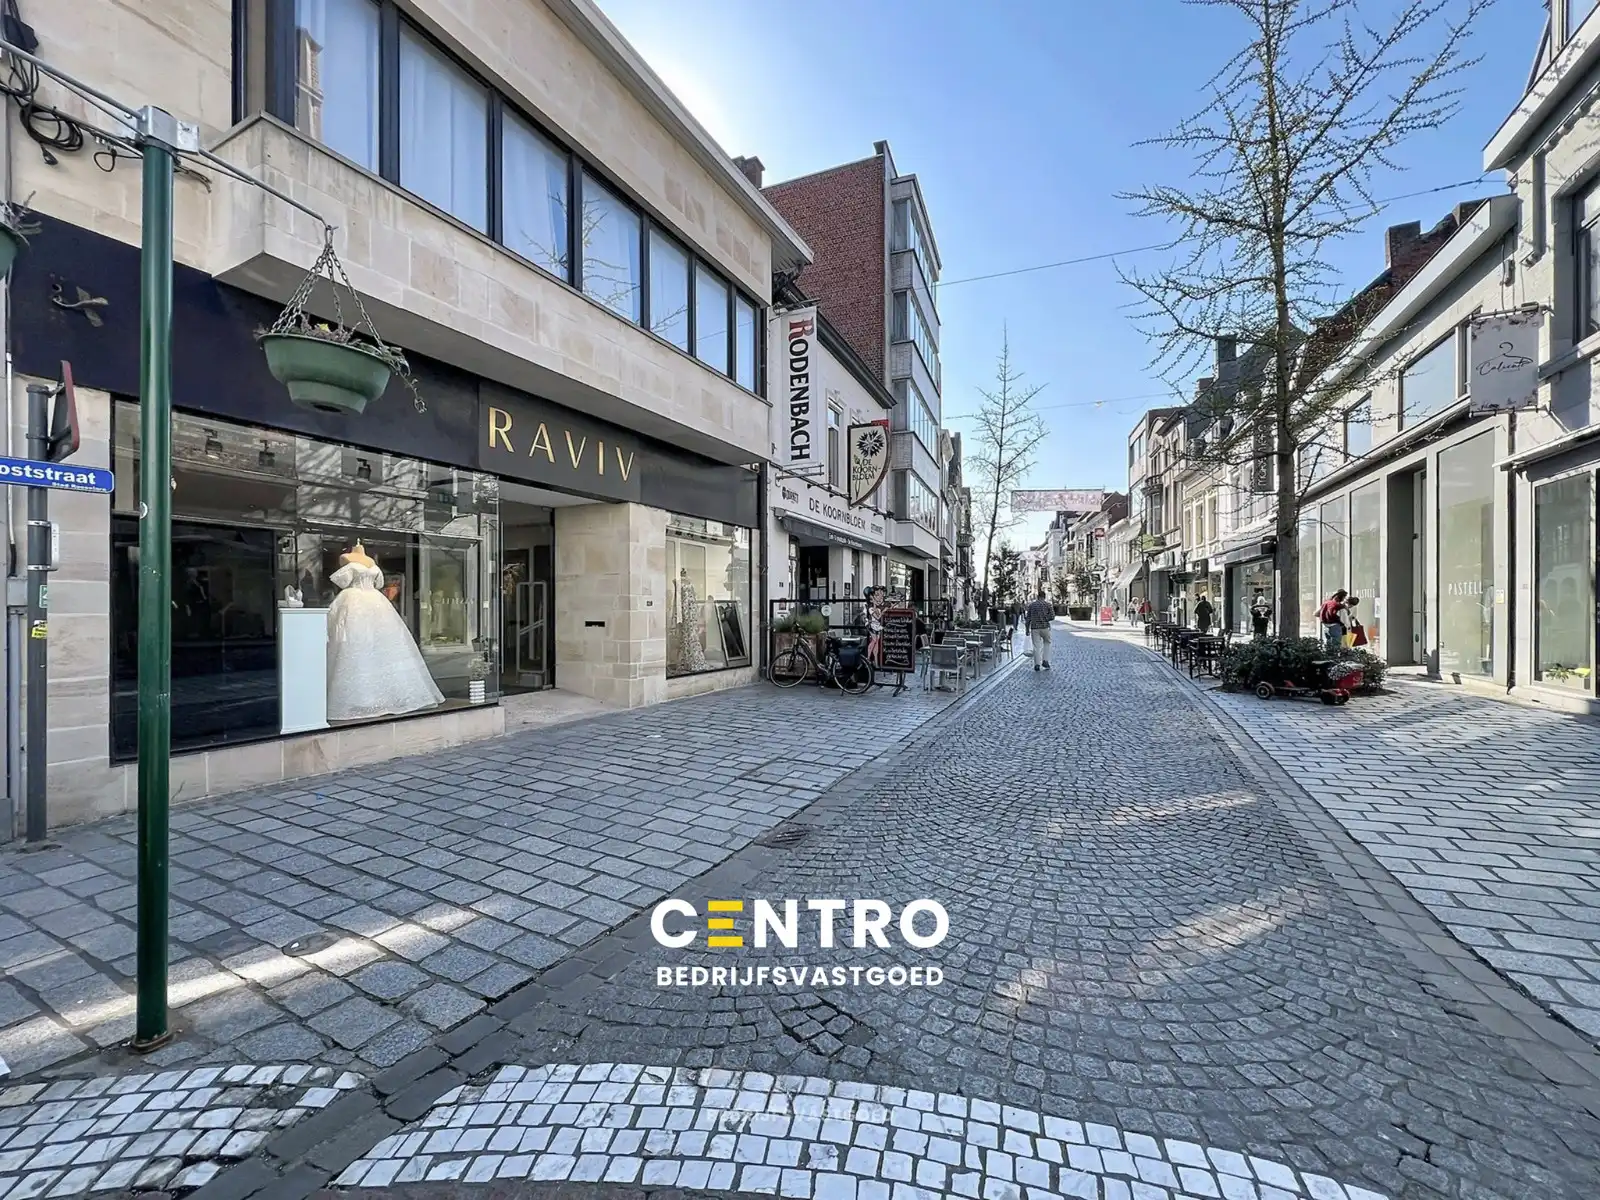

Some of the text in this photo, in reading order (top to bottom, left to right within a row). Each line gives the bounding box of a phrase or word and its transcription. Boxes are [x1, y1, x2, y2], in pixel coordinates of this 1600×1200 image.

[788, 315, 815, 462] RODENBACH
[487, 406, 636, 482] RAVIV
[809, 497, 820, 514] DE
[822, 503, 866, 530] KOORNBLOEM
[1448, 581, 1484, 596] PASTELL
